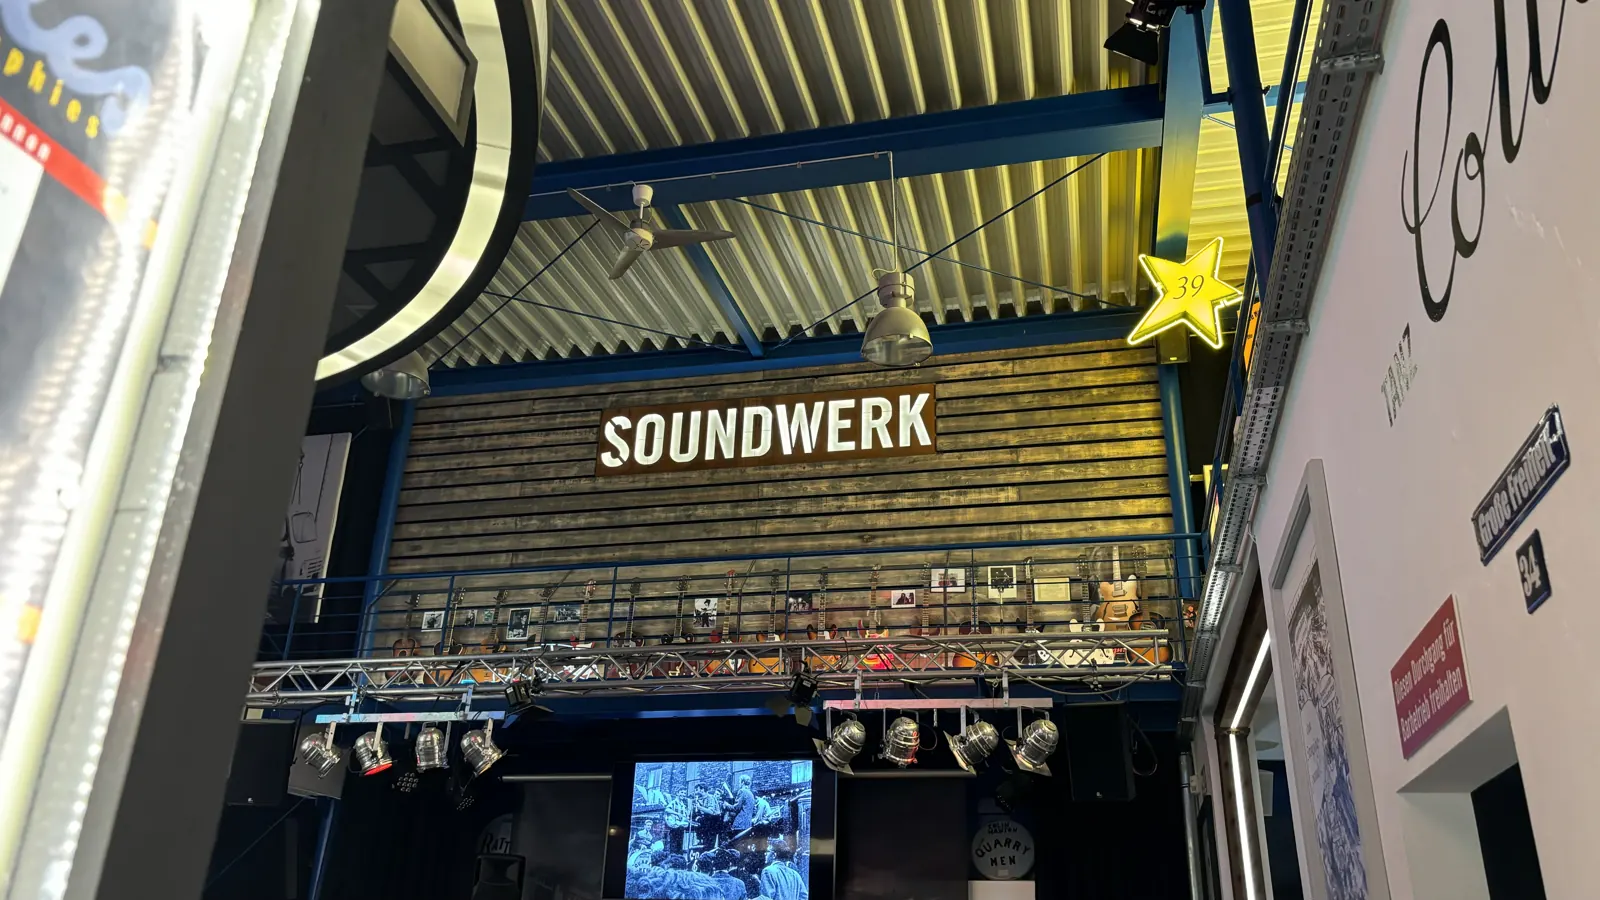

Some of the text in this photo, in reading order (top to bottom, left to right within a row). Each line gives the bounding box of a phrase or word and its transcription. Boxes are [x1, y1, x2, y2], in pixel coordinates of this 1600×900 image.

[0, 37, 100, 139] phies
[1173, 274, 1205, 300] 39
[600, 393, 932, 468] SOUNDWERK
[1478, 422, 1556, 548] Große Freiheit
[1519, 545, 1541, 597] 34
[1394, 618, 1456, 705] Diesen Durchgang für
[1400, 666, 1463, 742] Barbetrieb freihalten
[975, 837, 1031, 858] QUARRY
[990, 855, 1016, 867] MEN
